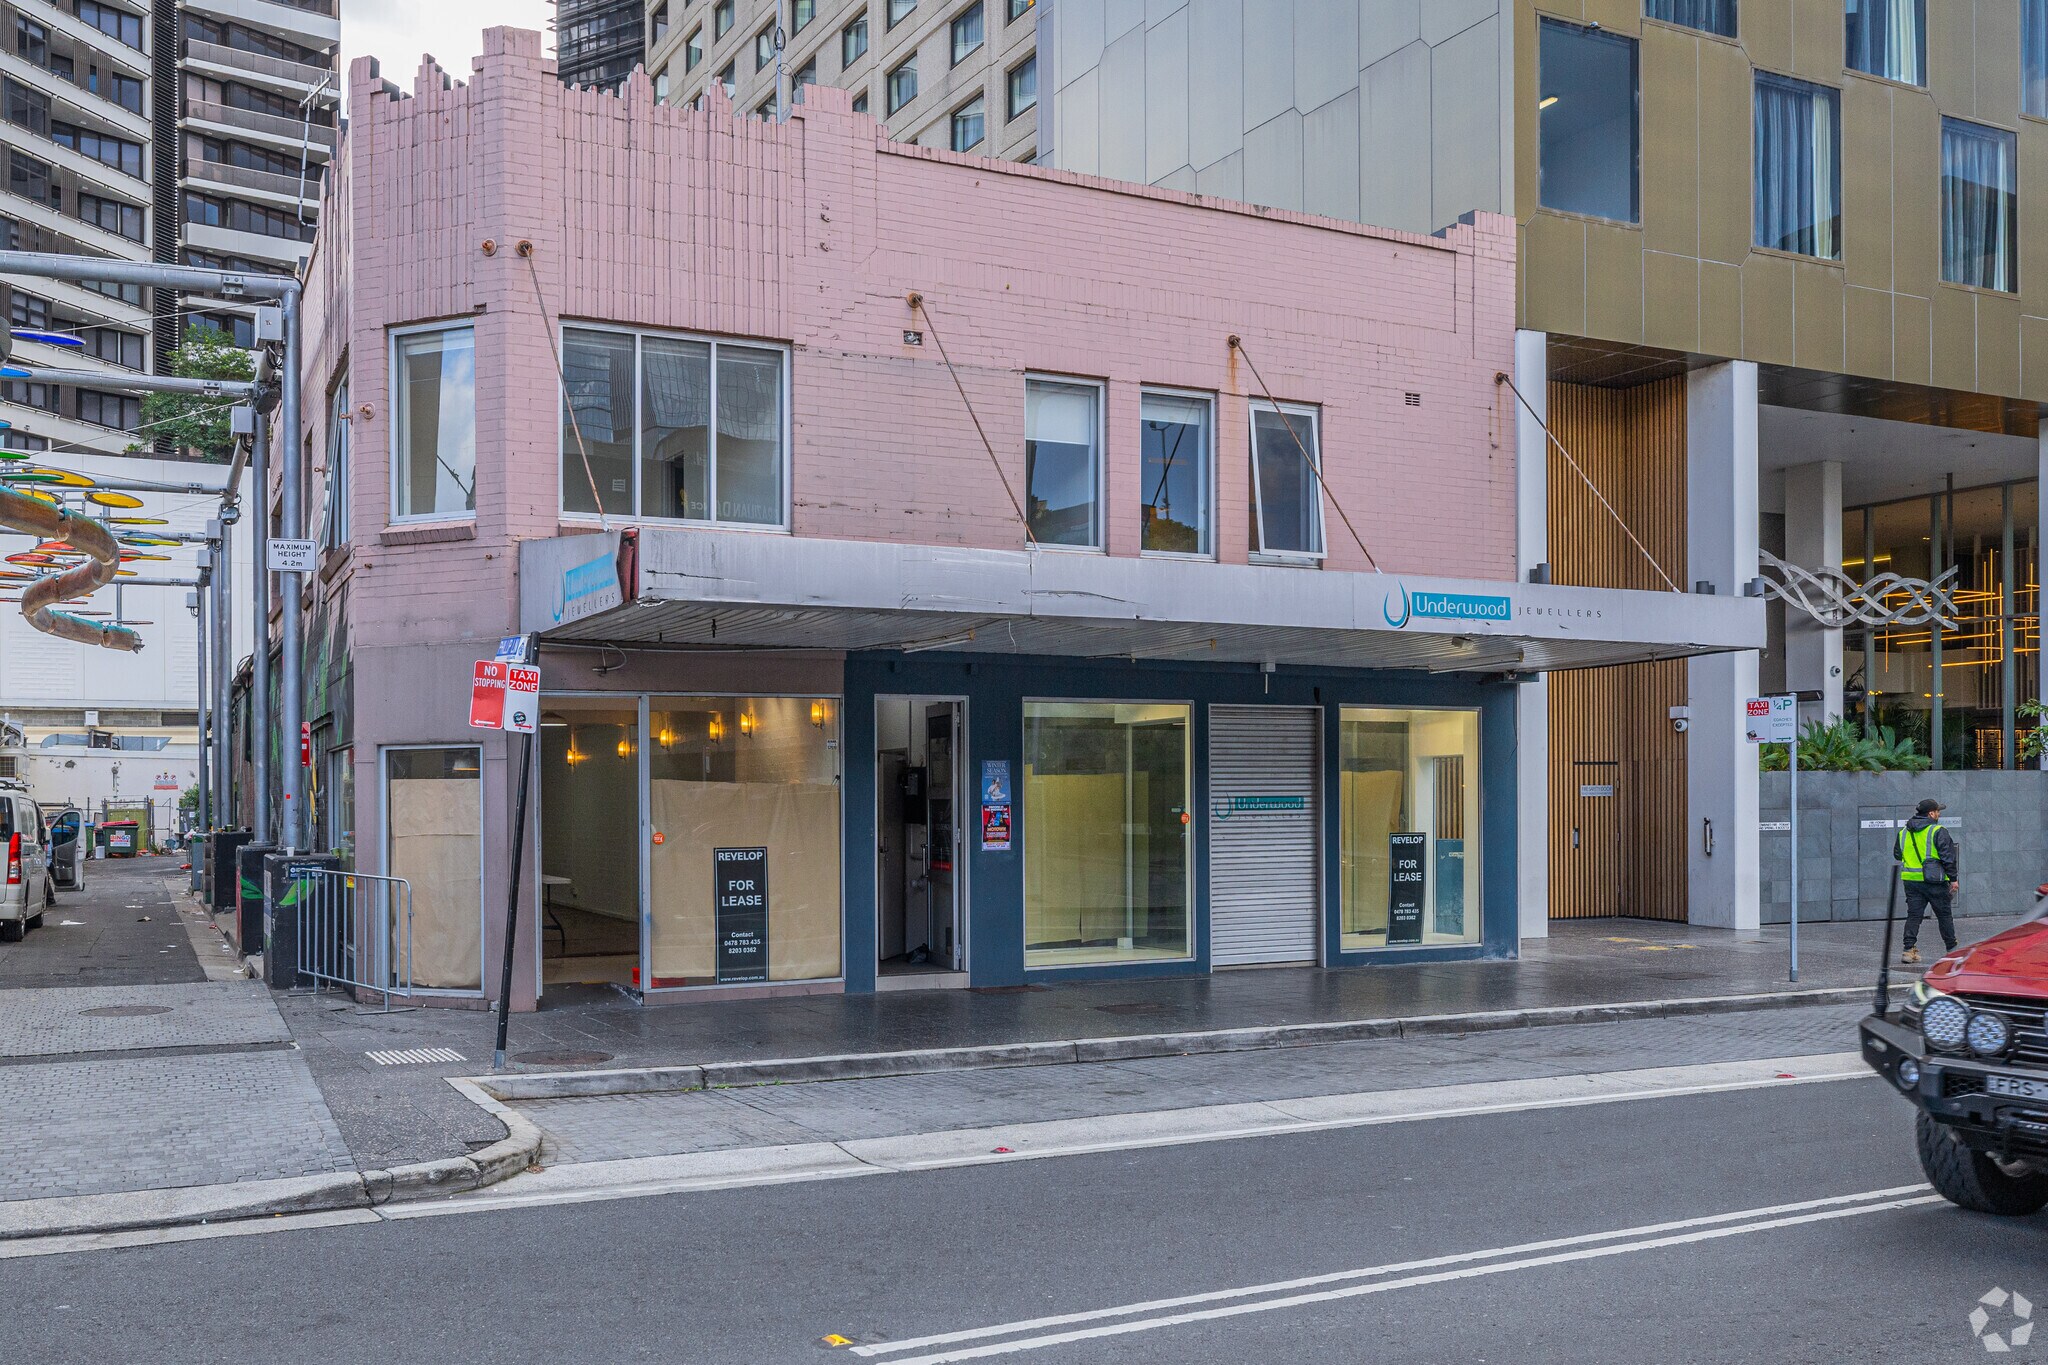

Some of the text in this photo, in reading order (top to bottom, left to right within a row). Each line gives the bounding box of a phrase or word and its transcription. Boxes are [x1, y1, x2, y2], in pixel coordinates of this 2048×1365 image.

[567, 592, 615, 620] JEWELLERS
[1415, 595, 1602, 618] Underwood JEWELLERS
[483, 665, 499, 677] NO
[512, 669, 537, 681] TAXI
[474, 677, 506, 689] STOPPING
[509, 680, 538, 692] ZONE
[1748, 701, 1768, 709] TAXI
[1237, 797, 1302, 809] Underwood
[1392, 836, 1424, 844] REVELOP
[718, 851, 763, 861] REVELOP
[1399, 859, 1417, 869] FOR
[1393, 872, 1422, 882] LEASE
[728, 880, 755, 891] FOR
[721, 894, 762, 907] LEASE
[720, 974, 765, 982] www.revelop.com.au
[1997, 1078, 2048, 1095] FRS-
